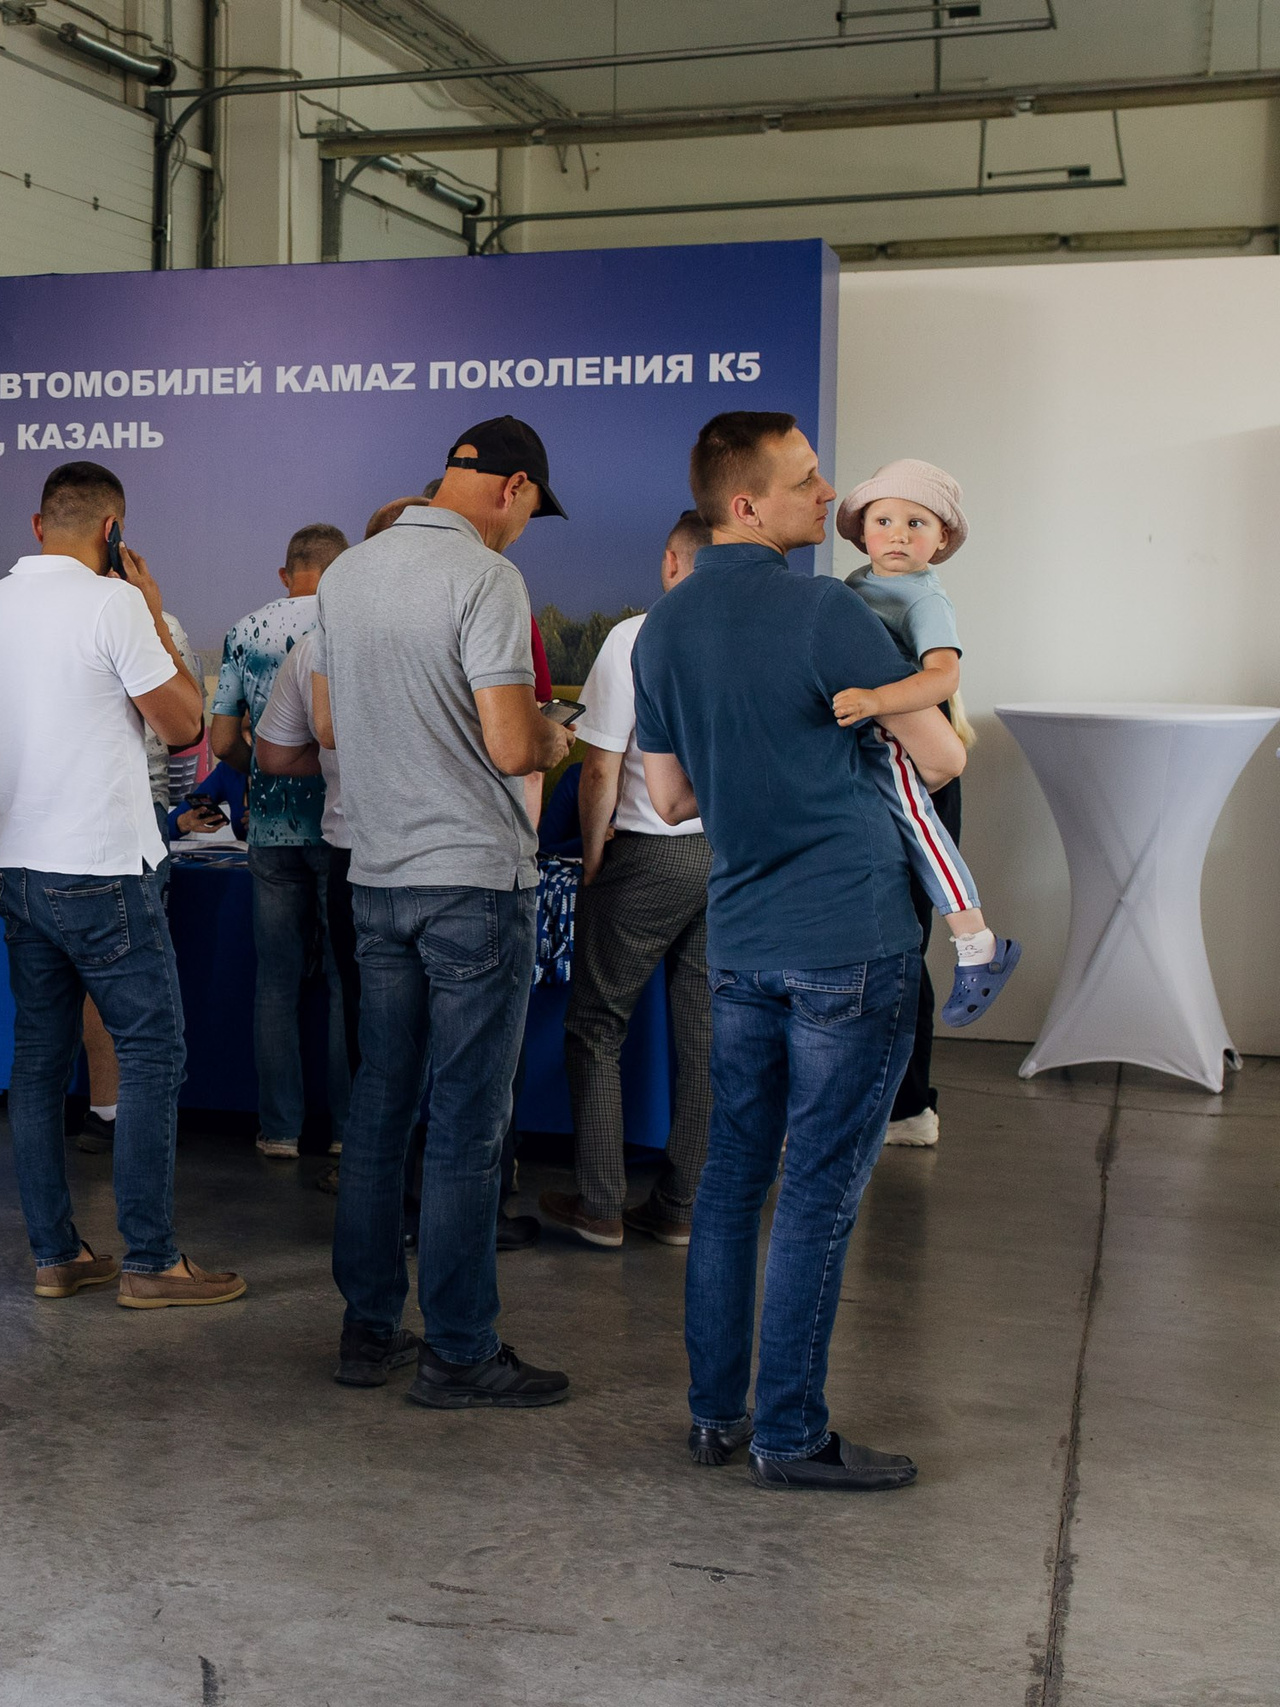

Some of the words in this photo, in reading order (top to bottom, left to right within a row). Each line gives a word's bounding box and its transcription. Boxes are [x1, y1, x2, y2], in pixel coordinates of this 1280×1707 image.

[275, 362, 416, 393] KAMAZ
[428, 353, 693, 390] ПОКОЛЕНИЯ
[708, 351, 761, 383] К5
[17, 421, 164, 450] КАЗАНЬ
